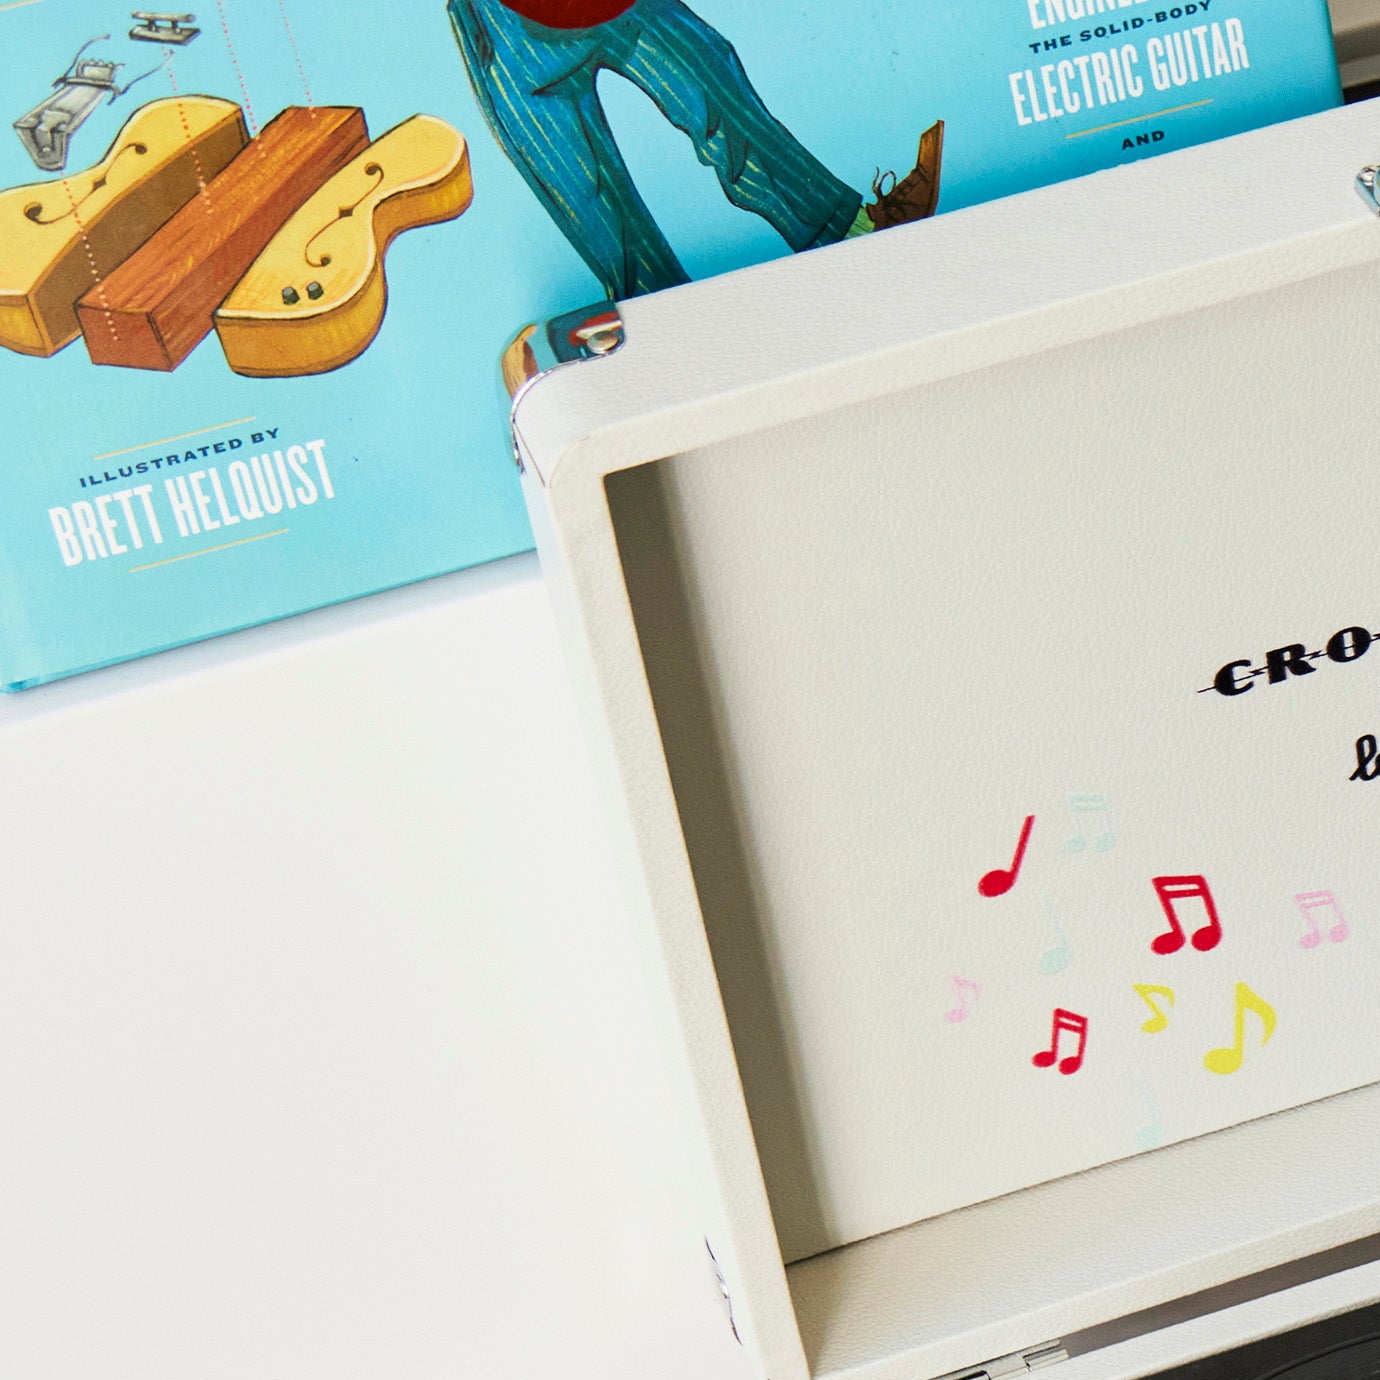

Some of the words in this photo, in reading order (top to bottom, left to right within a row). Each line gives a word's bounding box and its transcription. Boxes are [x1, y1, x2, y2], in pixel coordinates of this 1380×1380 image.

[1028, 34, 1072, 54] THE
[1079, 0, 1211, 42] SOLID-BODY
[1008, 43, 1145, 126] ELECTRIC
[1146, 17, 1250, 91] GUITAR
[1121, 130, 1166, 150] AND
[79, 437, 243, 488] ILLUSTRATED
[250, 427, 280, 445] BY
[47, 484, 163, 567] BRETT
[165, 438, 336, 538] HELQUIST
